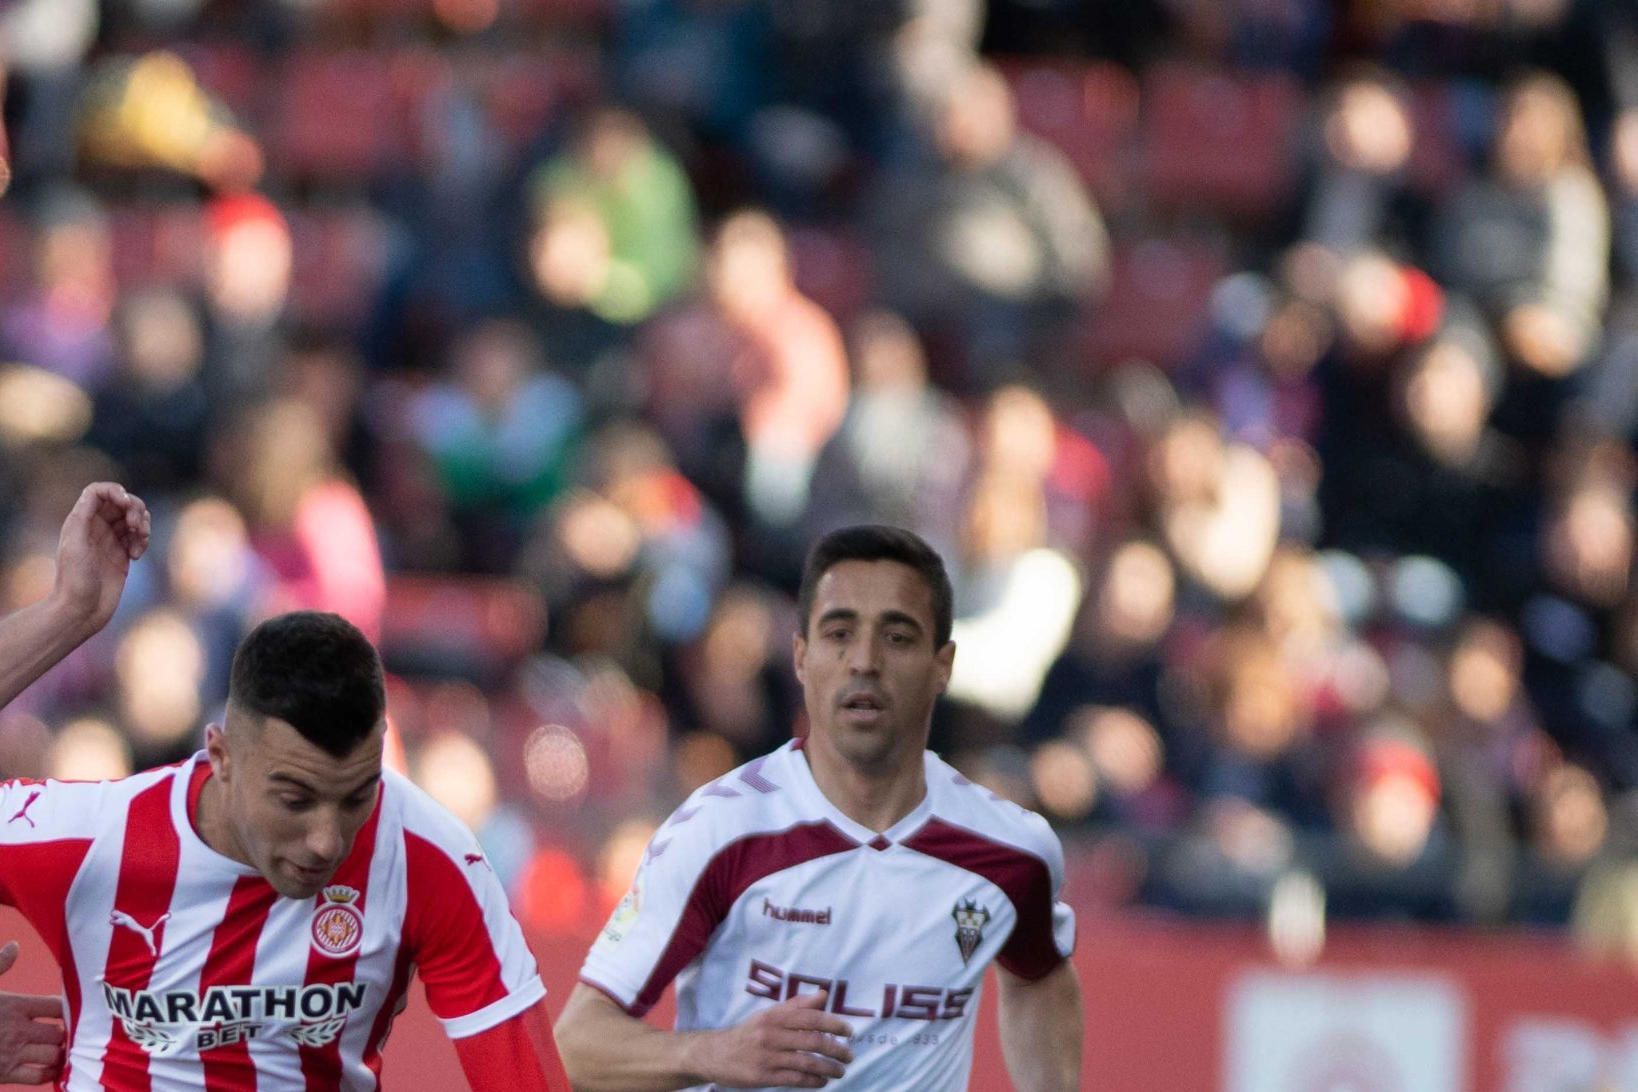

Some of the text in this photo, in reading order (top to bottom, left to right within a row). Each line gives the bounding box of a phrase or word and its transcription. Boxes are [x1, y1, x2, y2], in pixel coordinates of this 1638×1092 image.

[762, 898, 833, 925] hummel
[103, 983, 367, 1024] MARATHON
[746, 957, 975, 1021] SOLISS
[197, 1026, 260, 1048] BET
